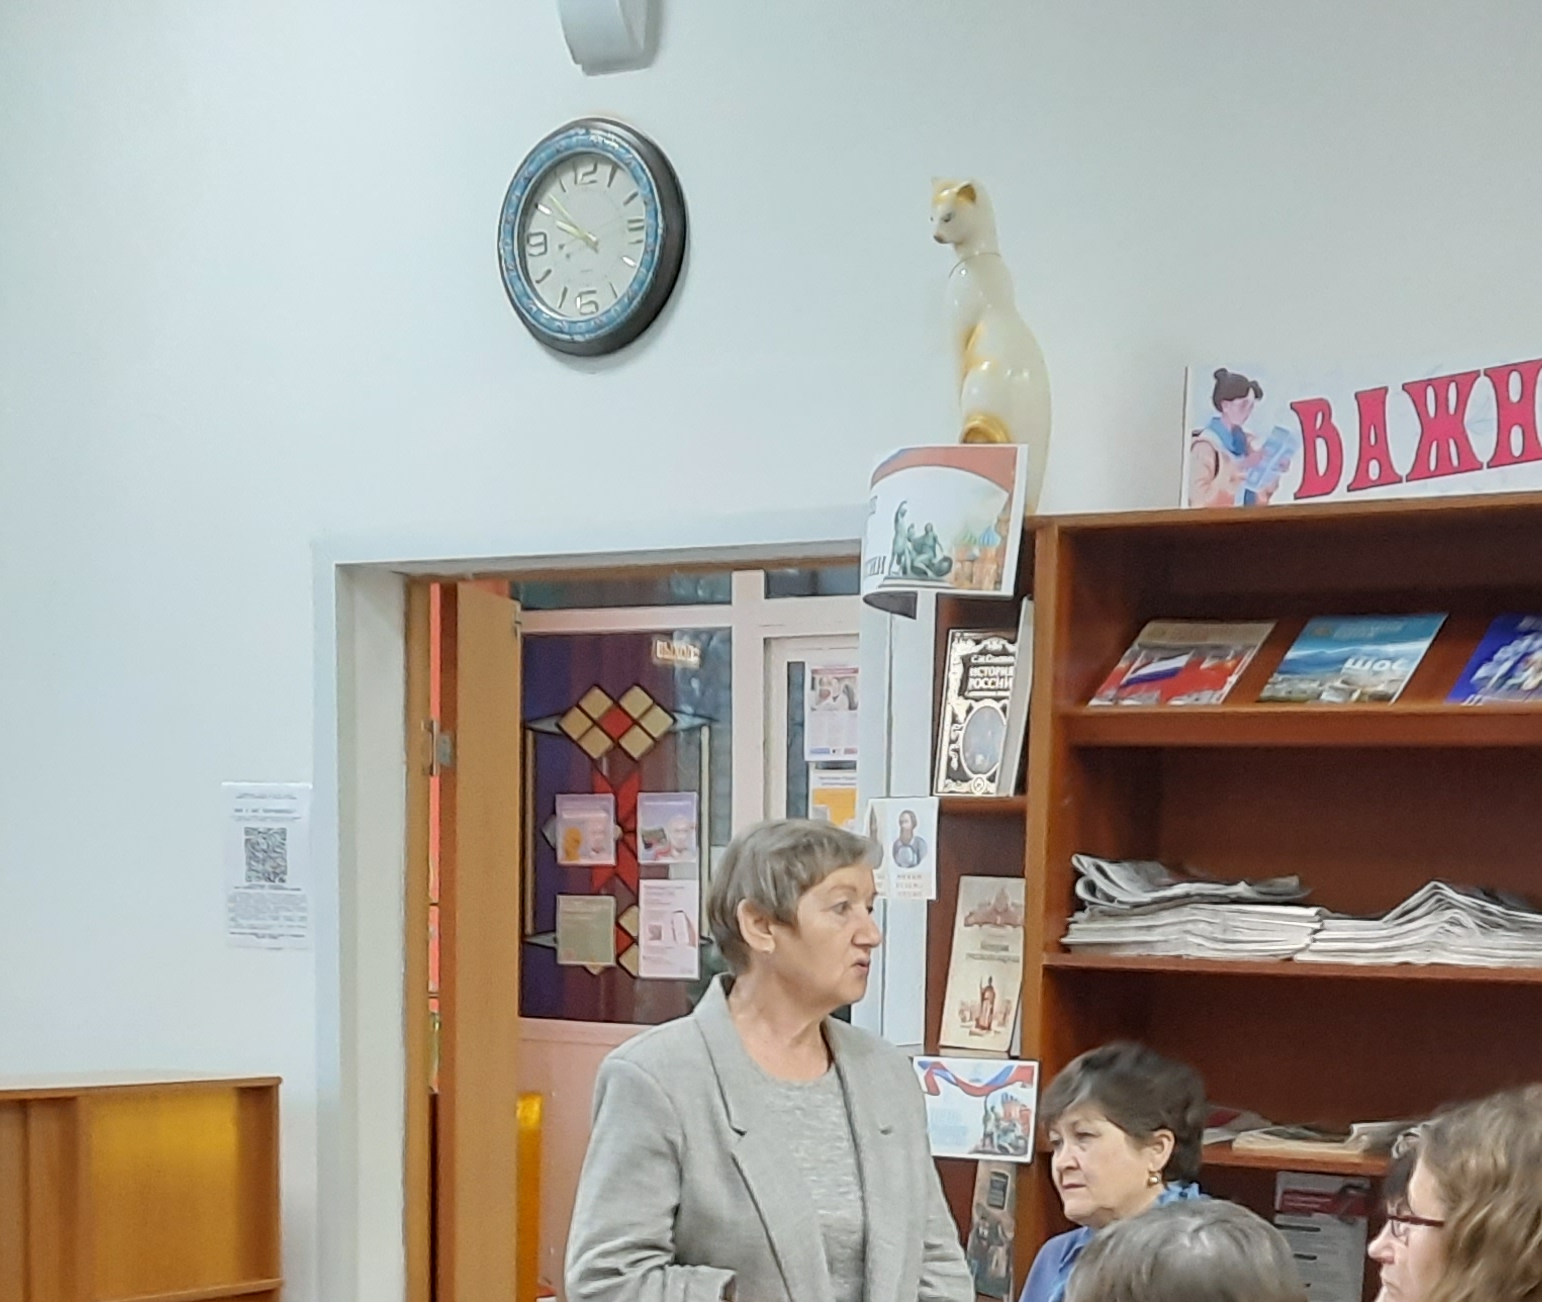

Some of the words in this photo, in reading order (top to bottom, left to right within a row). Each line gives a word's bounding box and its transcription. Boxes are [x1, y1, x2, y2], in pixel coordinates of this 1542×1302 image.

[573, 160, 599, 186] 12
[526, 230, 548, 257] 9
[576, 289, 599, 316] 6
